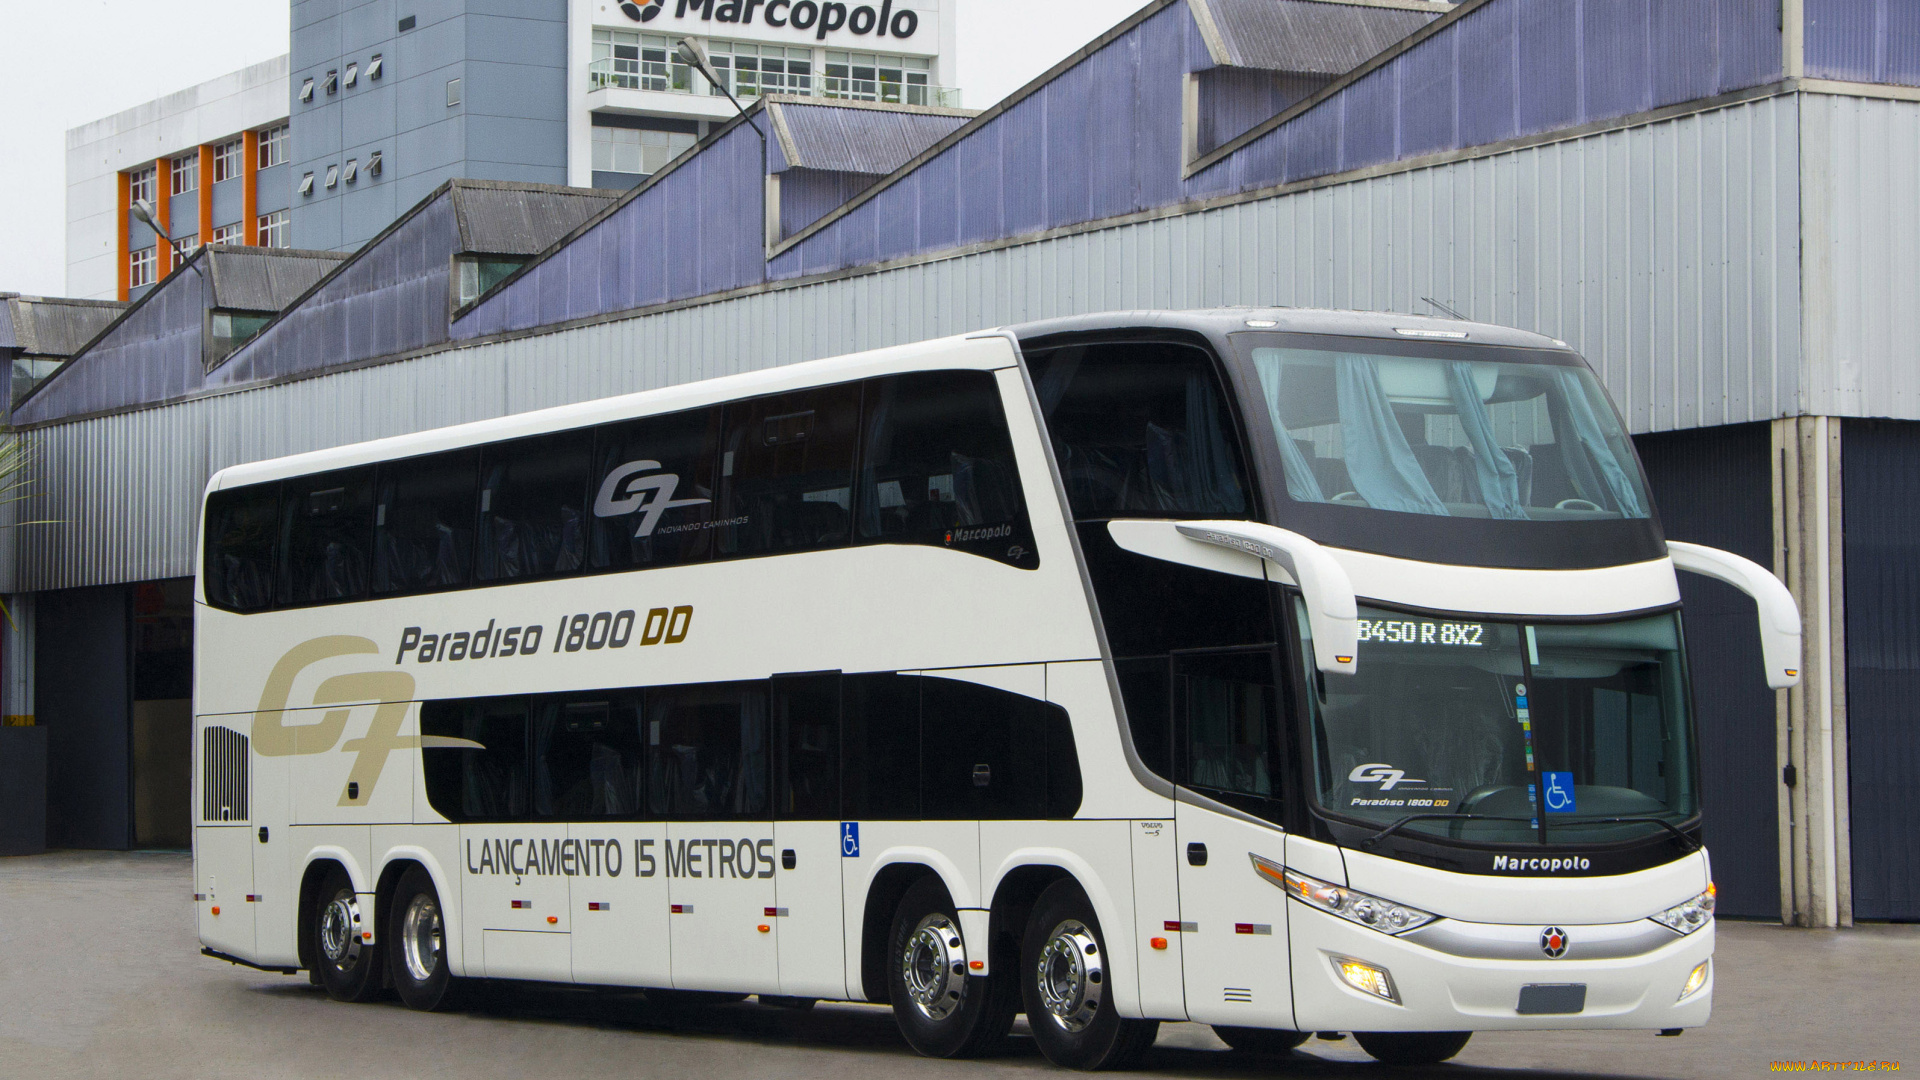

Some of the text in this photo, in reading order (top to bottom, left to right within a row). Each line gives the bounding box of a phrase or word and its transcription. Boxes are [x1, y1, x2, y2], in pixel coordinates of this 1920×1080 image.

[675, 0, 919, 40] Marcopolo
[657, 516, 749, 535] INOVANDO CAMINHOS
[954, 524, 1011, 542] Marcopolo
[395, 604, 694, 665] Paradiso 1800 DD
[1421, 622, 1436, 644] R
[1441, 623, 1483, 646] 8X2
[1350, 798, 1405, 806] Paradiso
[1433, 799, 1450, 807] DD
[467, 838, 775, 885] LANÇAMENTO 15 METROS
[1493, 855, 1591, 872] Marcopolo
